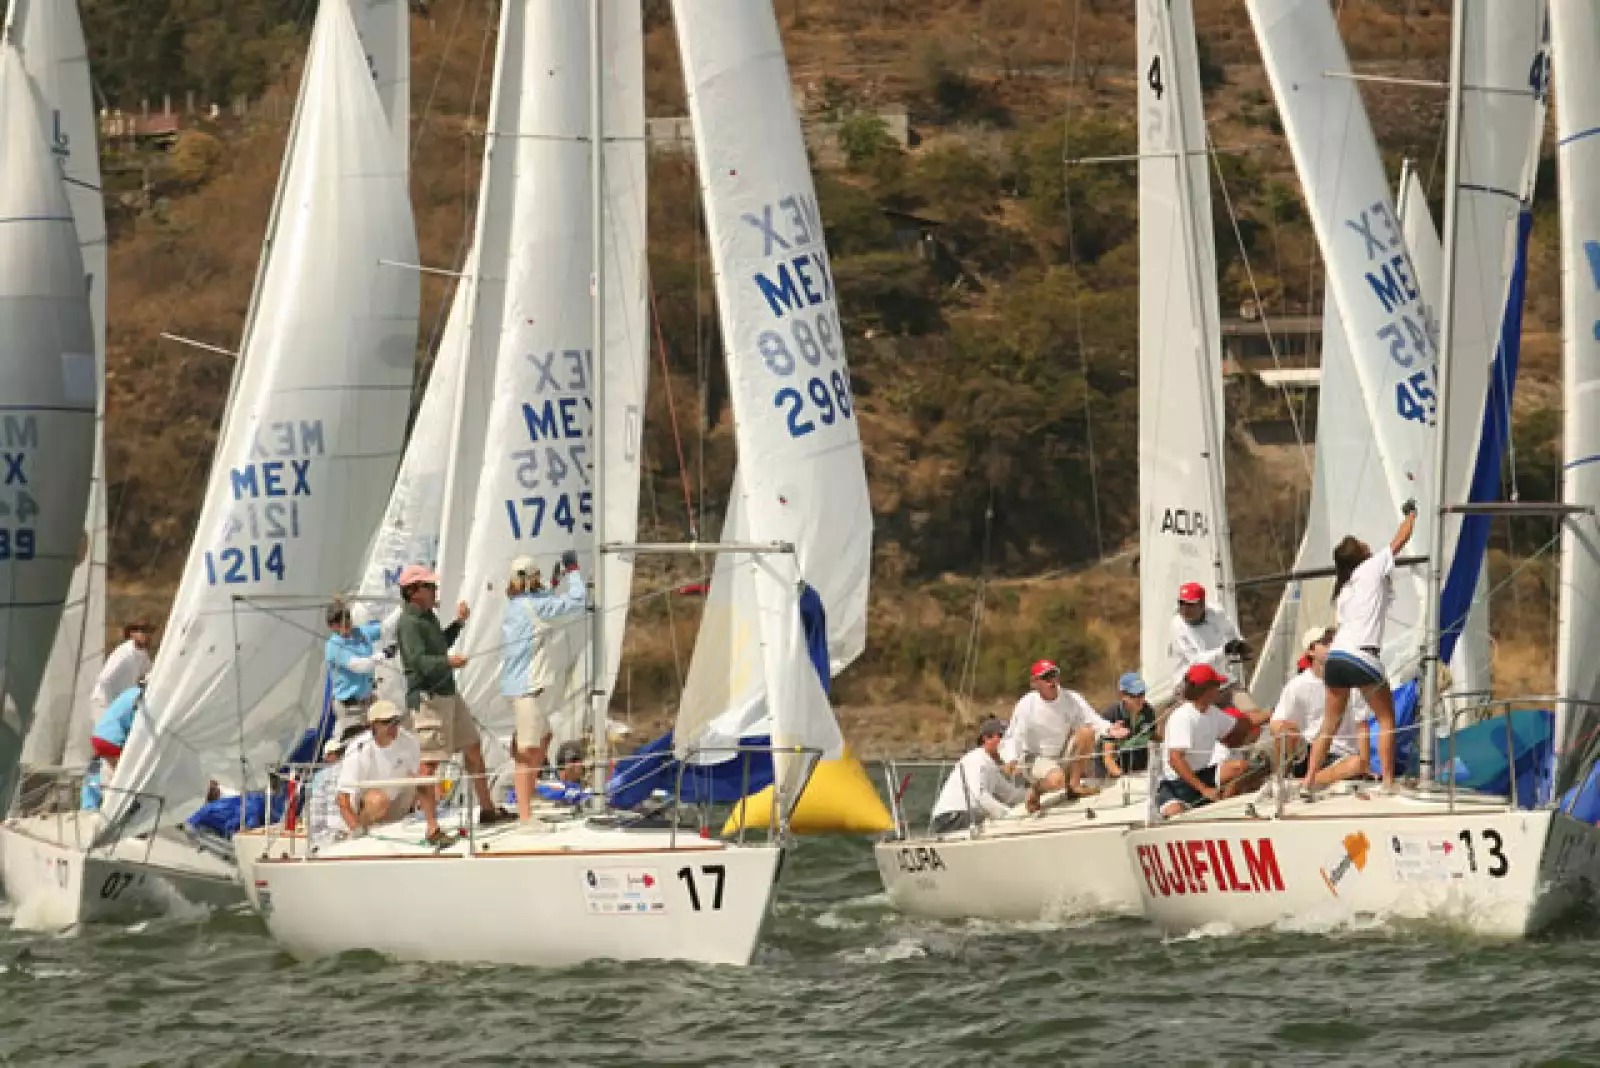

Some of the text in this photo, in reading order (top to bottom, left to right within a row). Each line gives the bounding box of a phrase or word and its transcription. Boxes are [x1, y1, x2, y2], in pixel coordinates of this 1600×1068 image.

[229, 459, 312, 500] MEX
[505, 492, 593, 541] 1745
[204, 542, 286, 586] 1214
[1136, 837, 1286, 898] FUJIFILM
[1458, 828, 1510, 879] 13
[676, 864, 726, 912] 17
